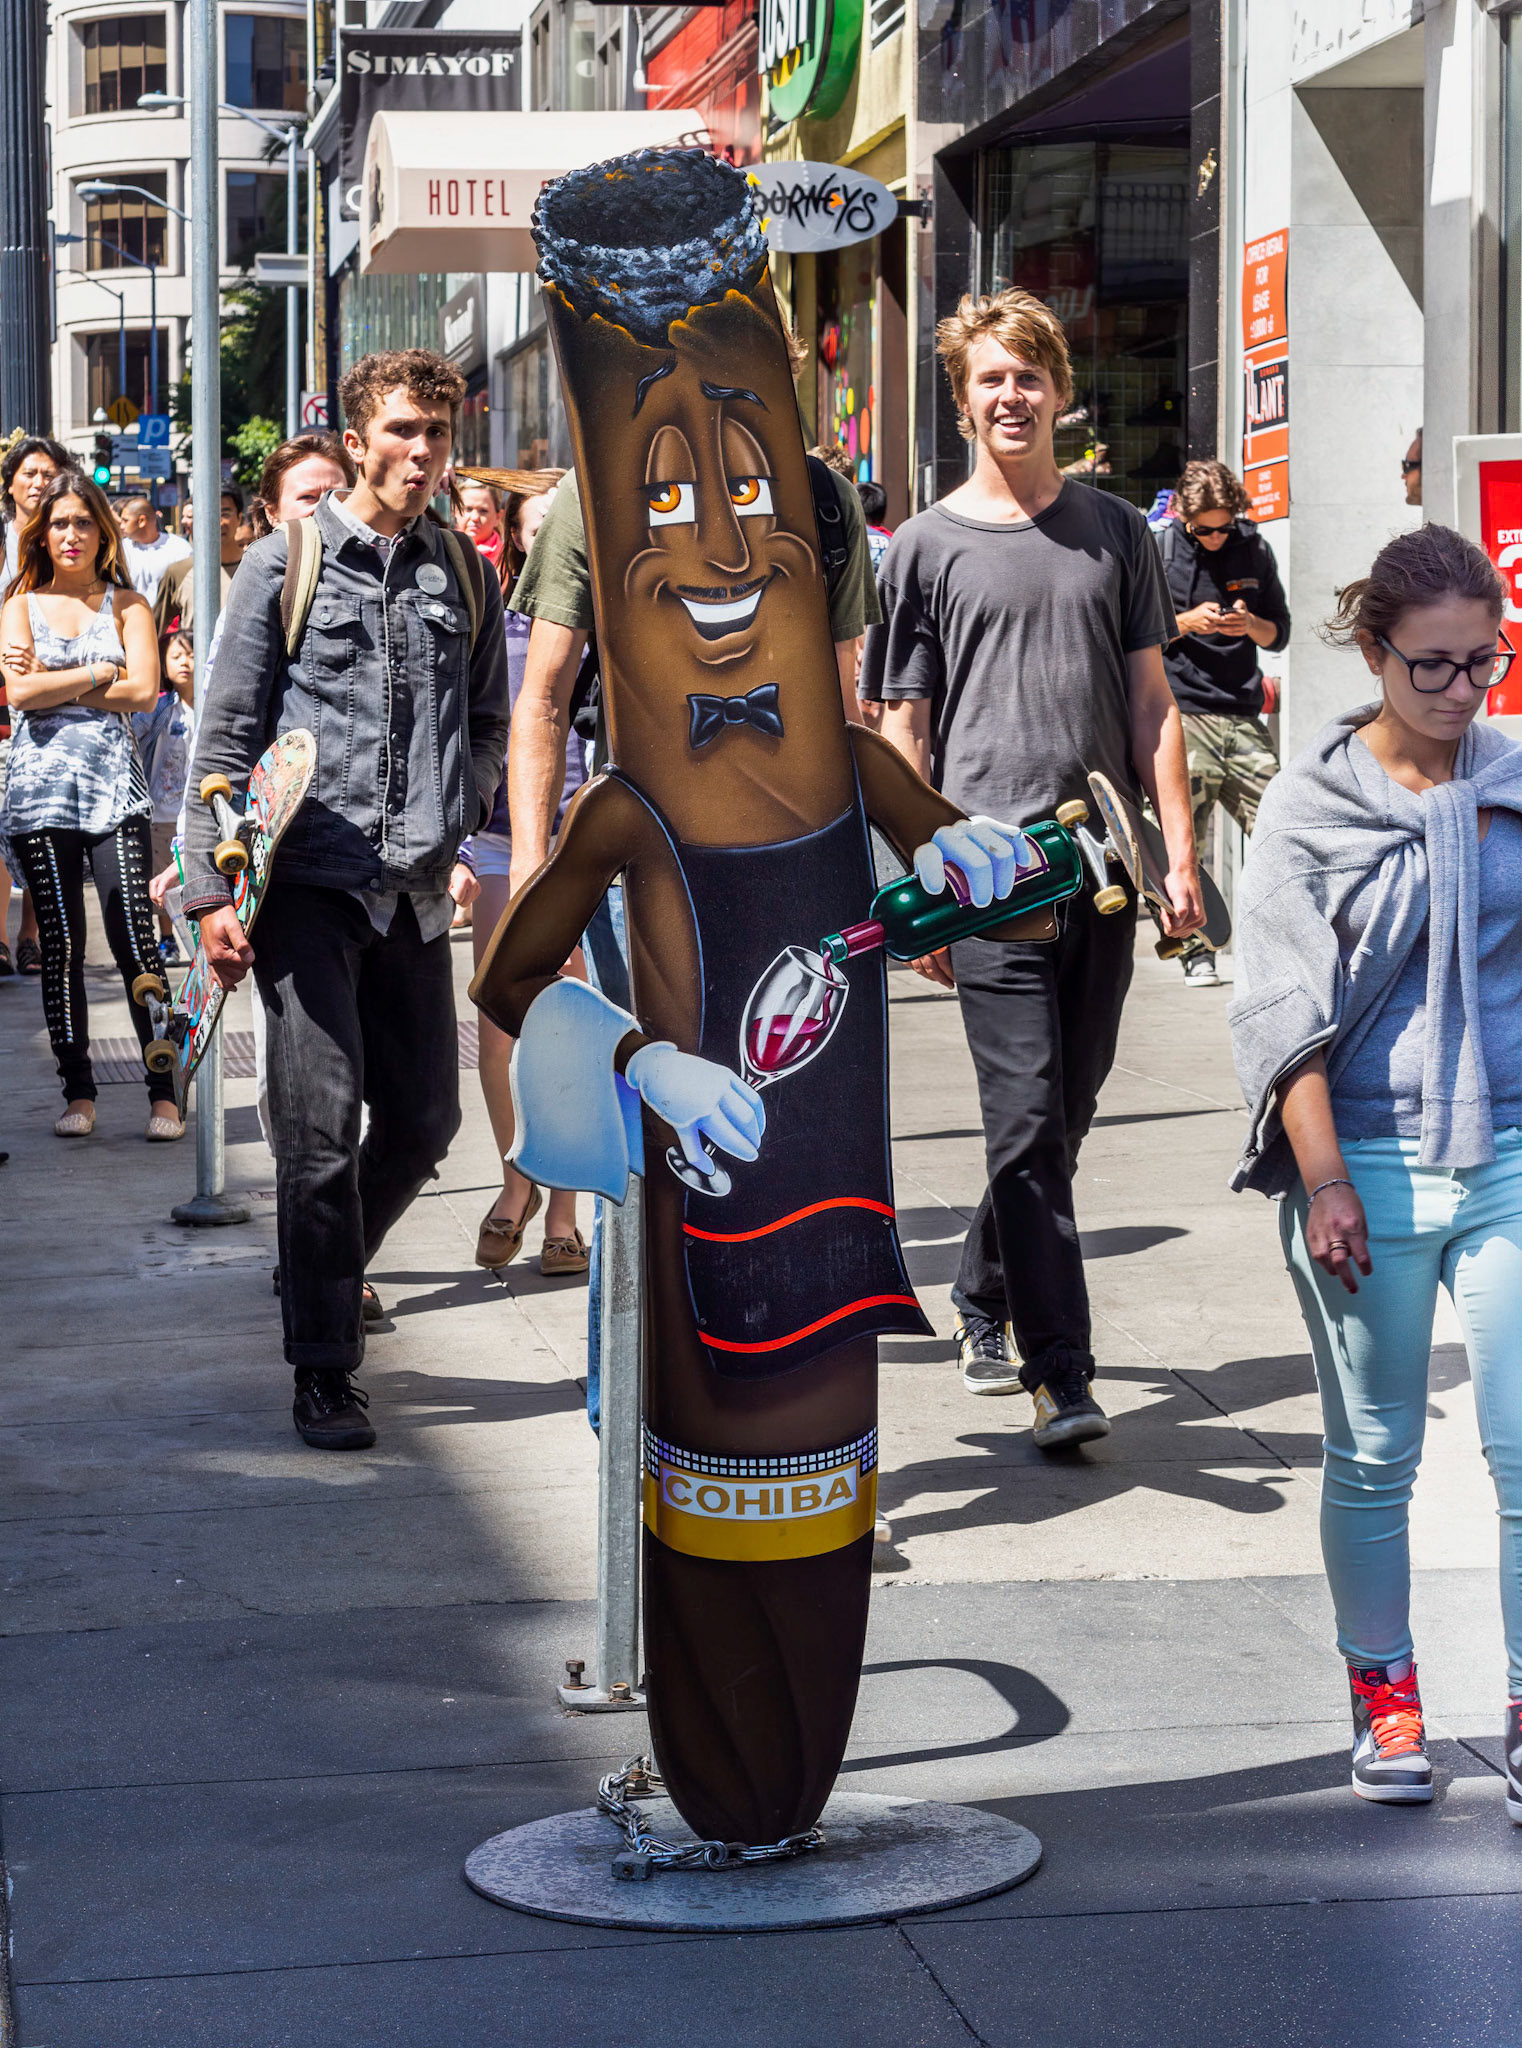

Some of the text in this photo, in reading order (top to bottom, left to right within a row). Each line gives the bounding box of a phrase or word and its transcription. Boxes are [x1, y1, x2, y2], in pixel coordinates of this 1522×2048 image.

[429, 179, 511, 216] HOTEL
[752, 172, 878, 234] OURNEYS
[1497, 528, 1522, 544] EXT
[665, 1475, 853, 1515] COHIBA
